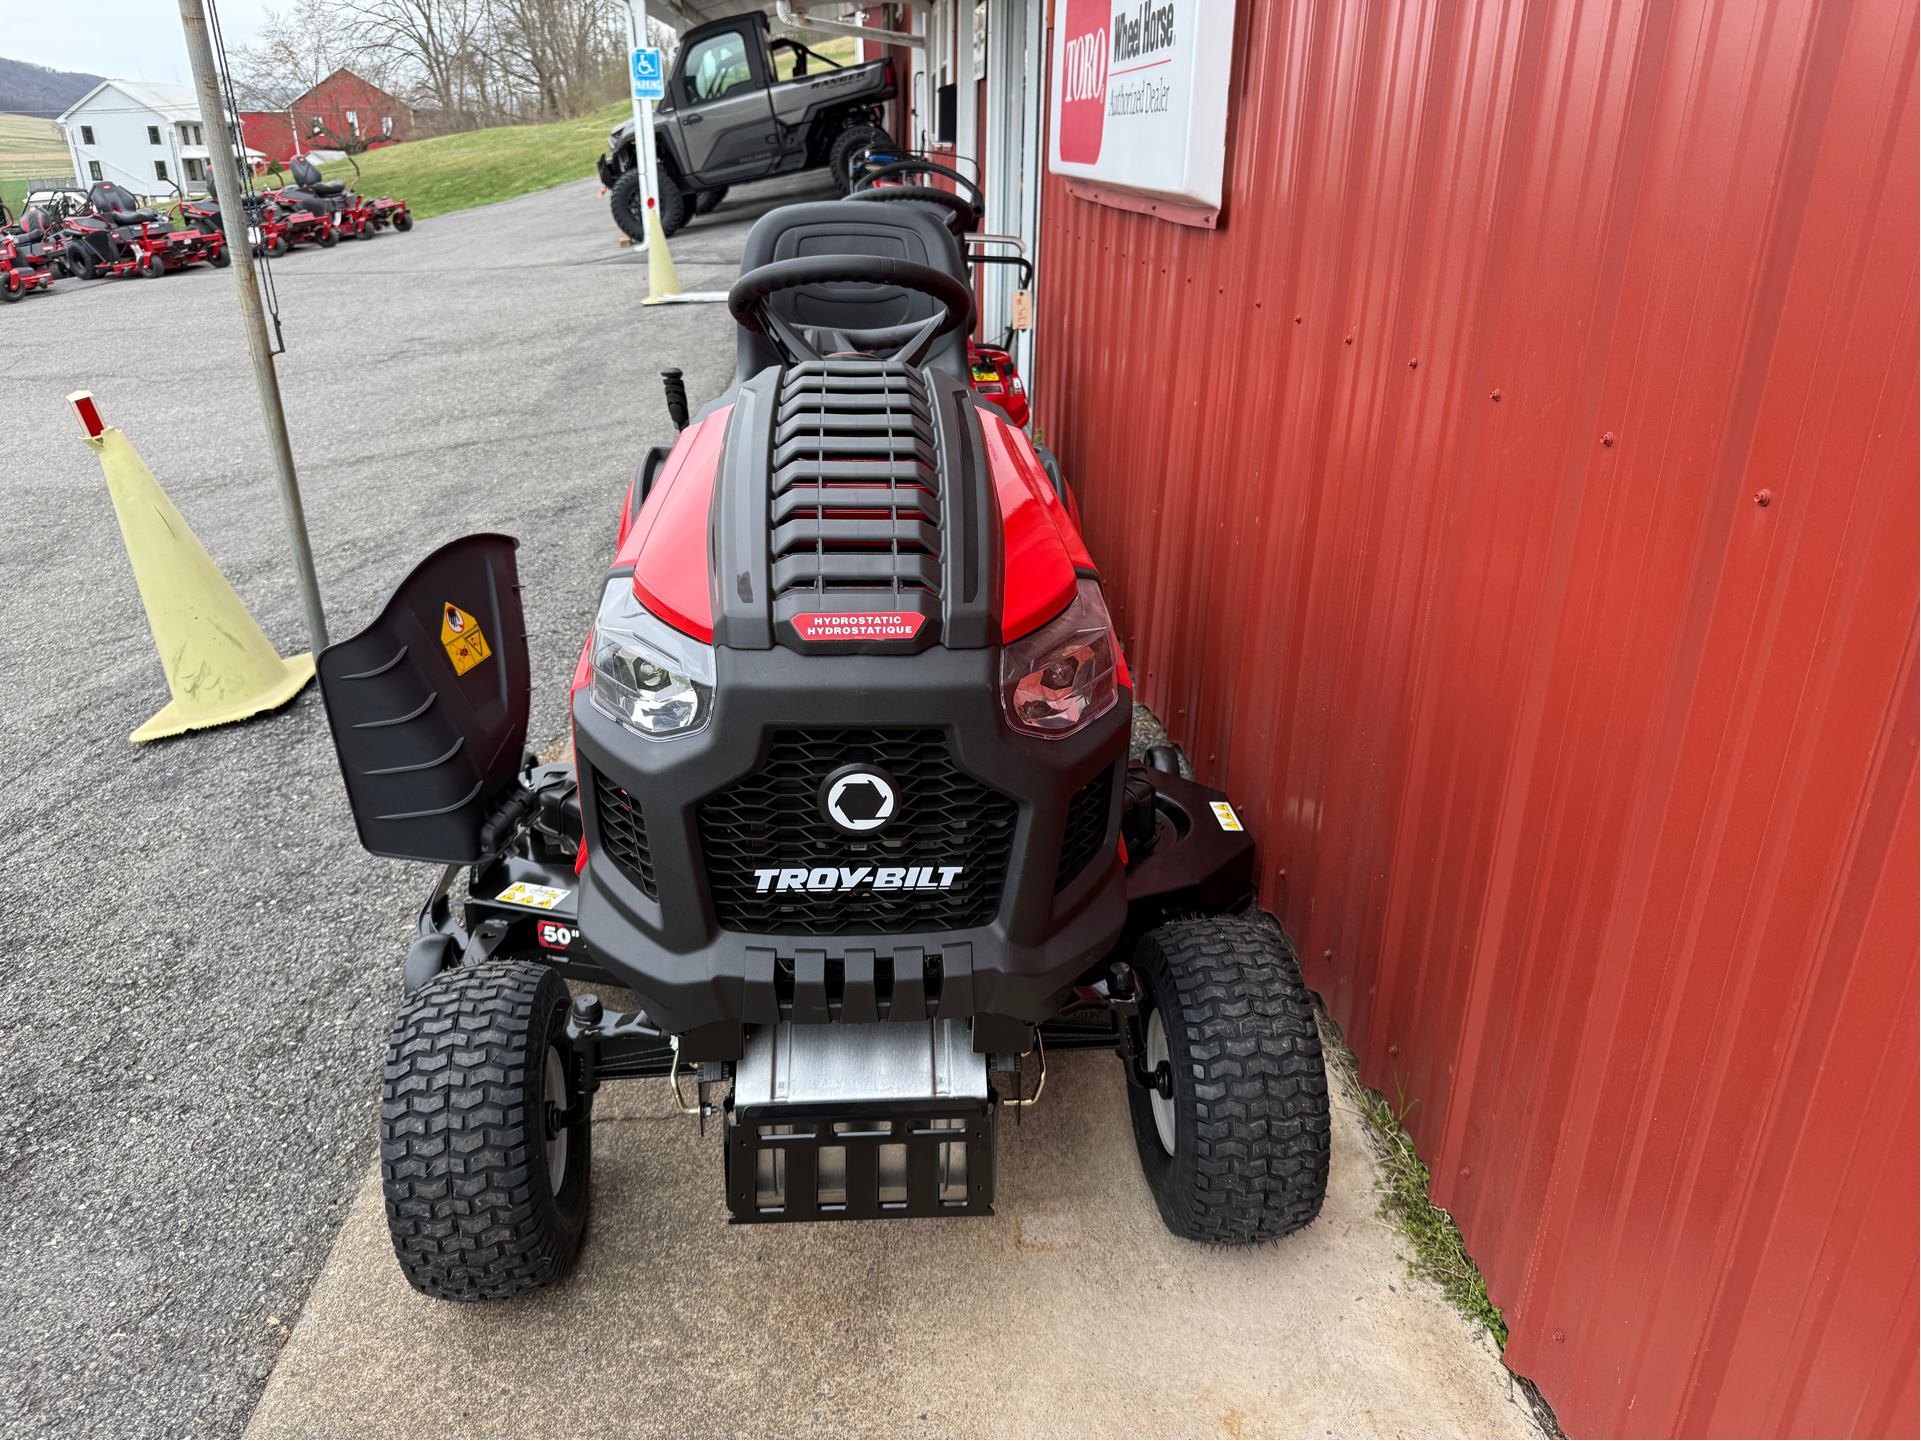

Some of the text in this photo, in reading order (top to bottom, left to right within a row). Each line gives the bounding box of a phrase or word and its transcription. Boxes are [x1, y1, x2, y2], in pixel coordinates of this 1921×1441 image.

[1113, 0, 1174, 63] Wheel Horse
[1065, 27, 1106, 102] TORO
[634, 79, 662, 90] PARKING
[811, 71, 867, 89] RANGER
[1108, 76, 1170, 116] Authorized Dealer
[807, 626, 912, 635] HYDROSTATIQUE
[814, 616, 902, 625] HYDROSTATIC
[754, 866, 963, 893] TROY-BILT
[543, 925, 580, 945] 50"
